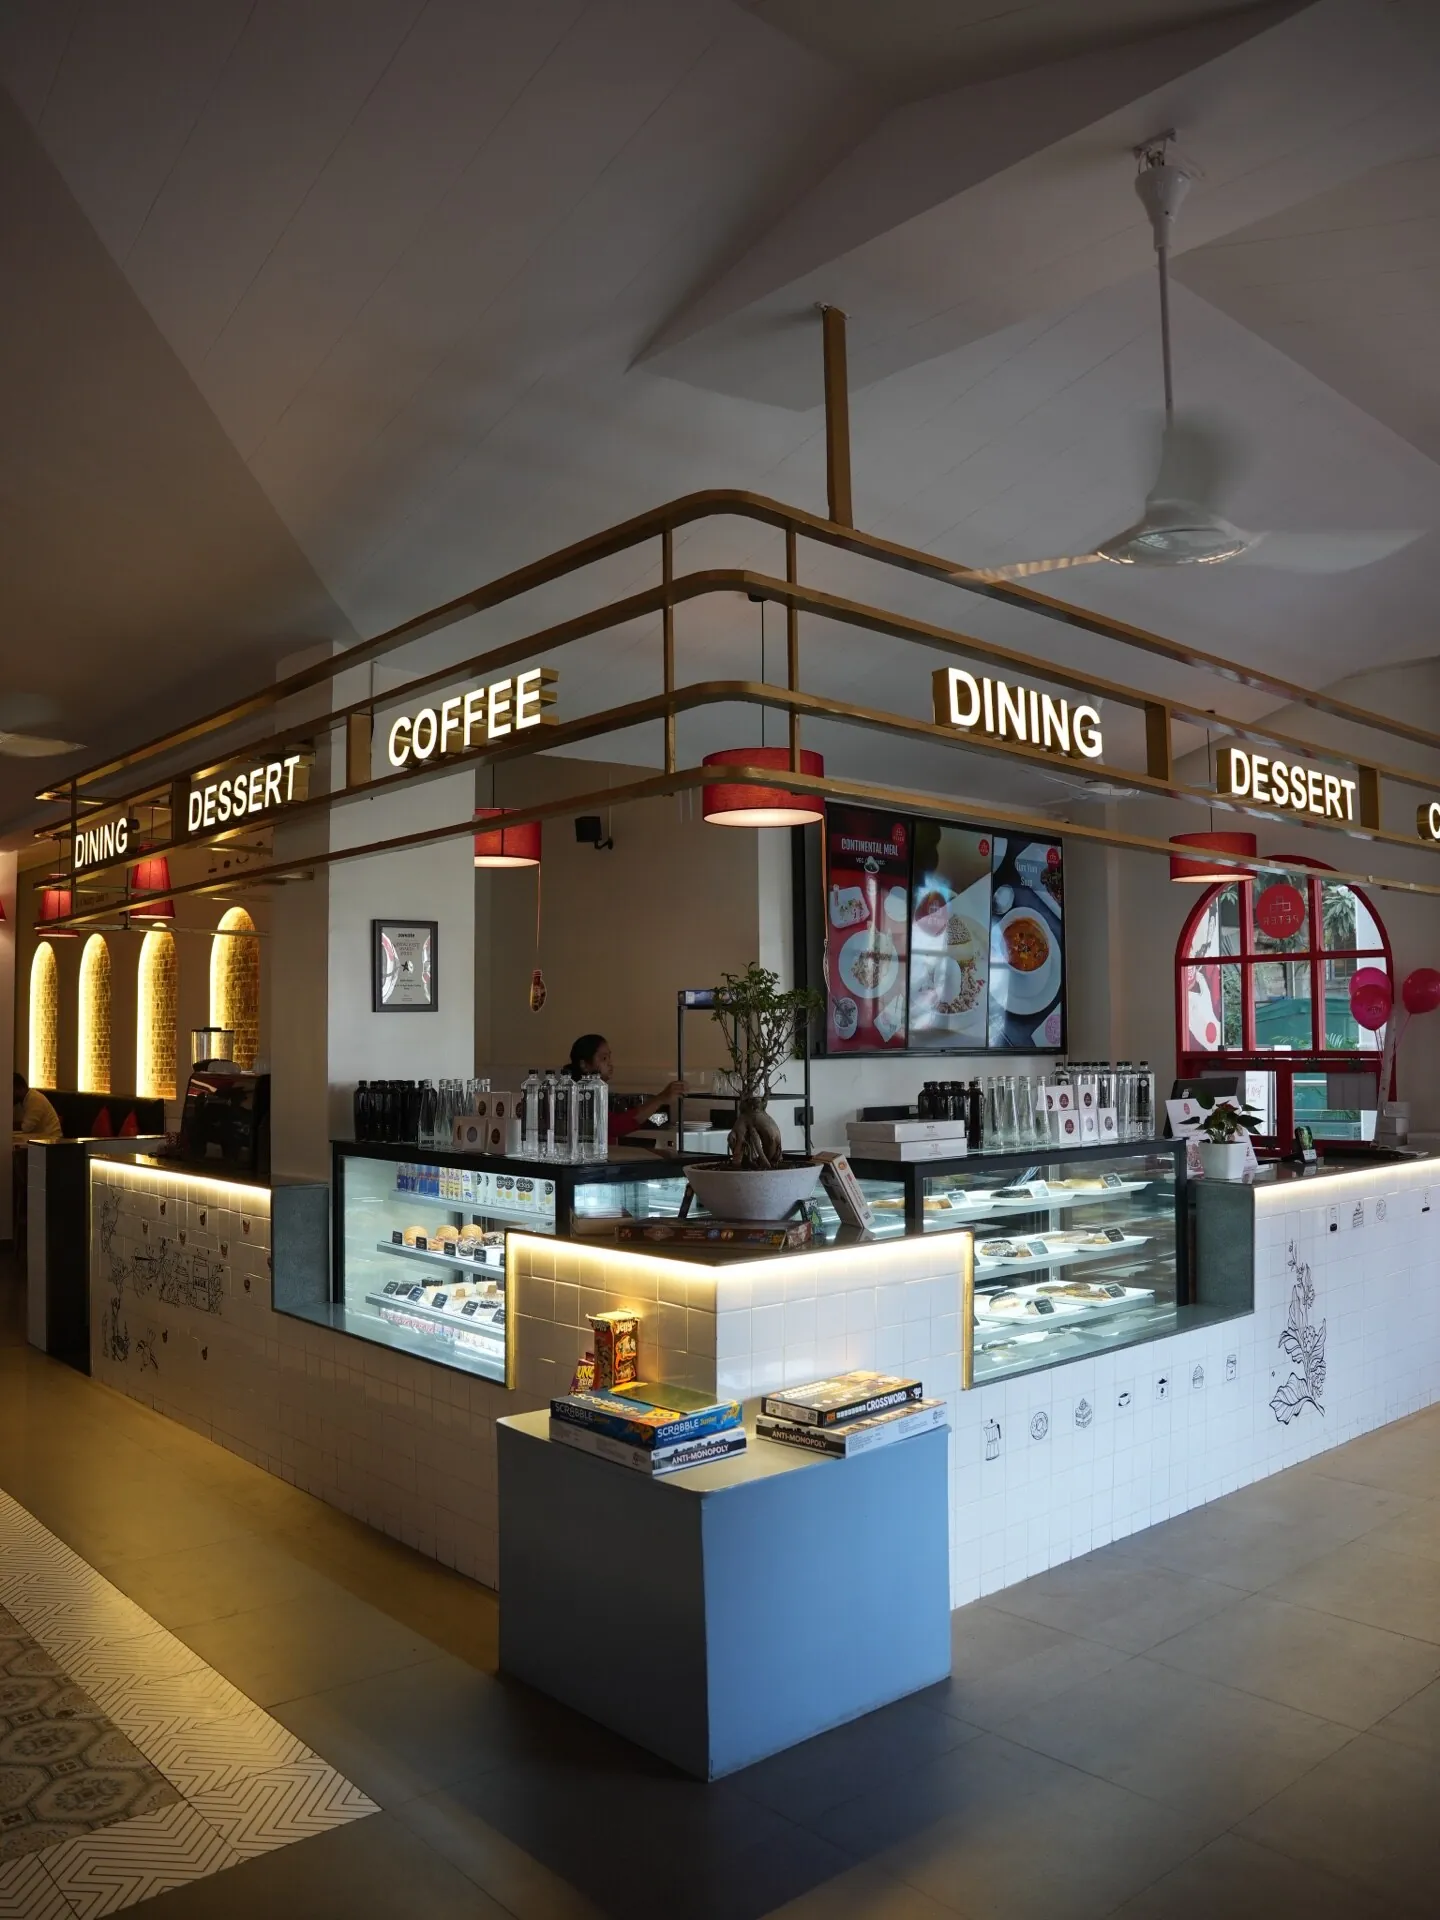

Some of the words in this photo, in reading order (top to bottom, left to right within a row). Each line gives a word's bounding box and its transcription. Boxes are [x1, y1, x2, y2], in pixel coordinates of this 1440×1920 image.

[388, 667, 541, 767] COFFEE
[948, 667, 1103, 758] DINING
[188, 755, 301, 832] DESSERT
[1230, 747, 1357, 822] DESSERT
[74, 817, 128, 868] DINING
[841, 838, 883, 854] CONTINENTAL
[883, 843, 899, 856] MEAL
[866, 1391, 907, 1411] CROSSWORD
[555, 1403, 593, 1420] SCRABBLE
[658, 1418, 700, 1438] SCRABBLE
[772, 1430, 827, 1448] ANTI-MONOPOLY
[672, 1444, 729, 1464] ANTI-MONOPOLY
